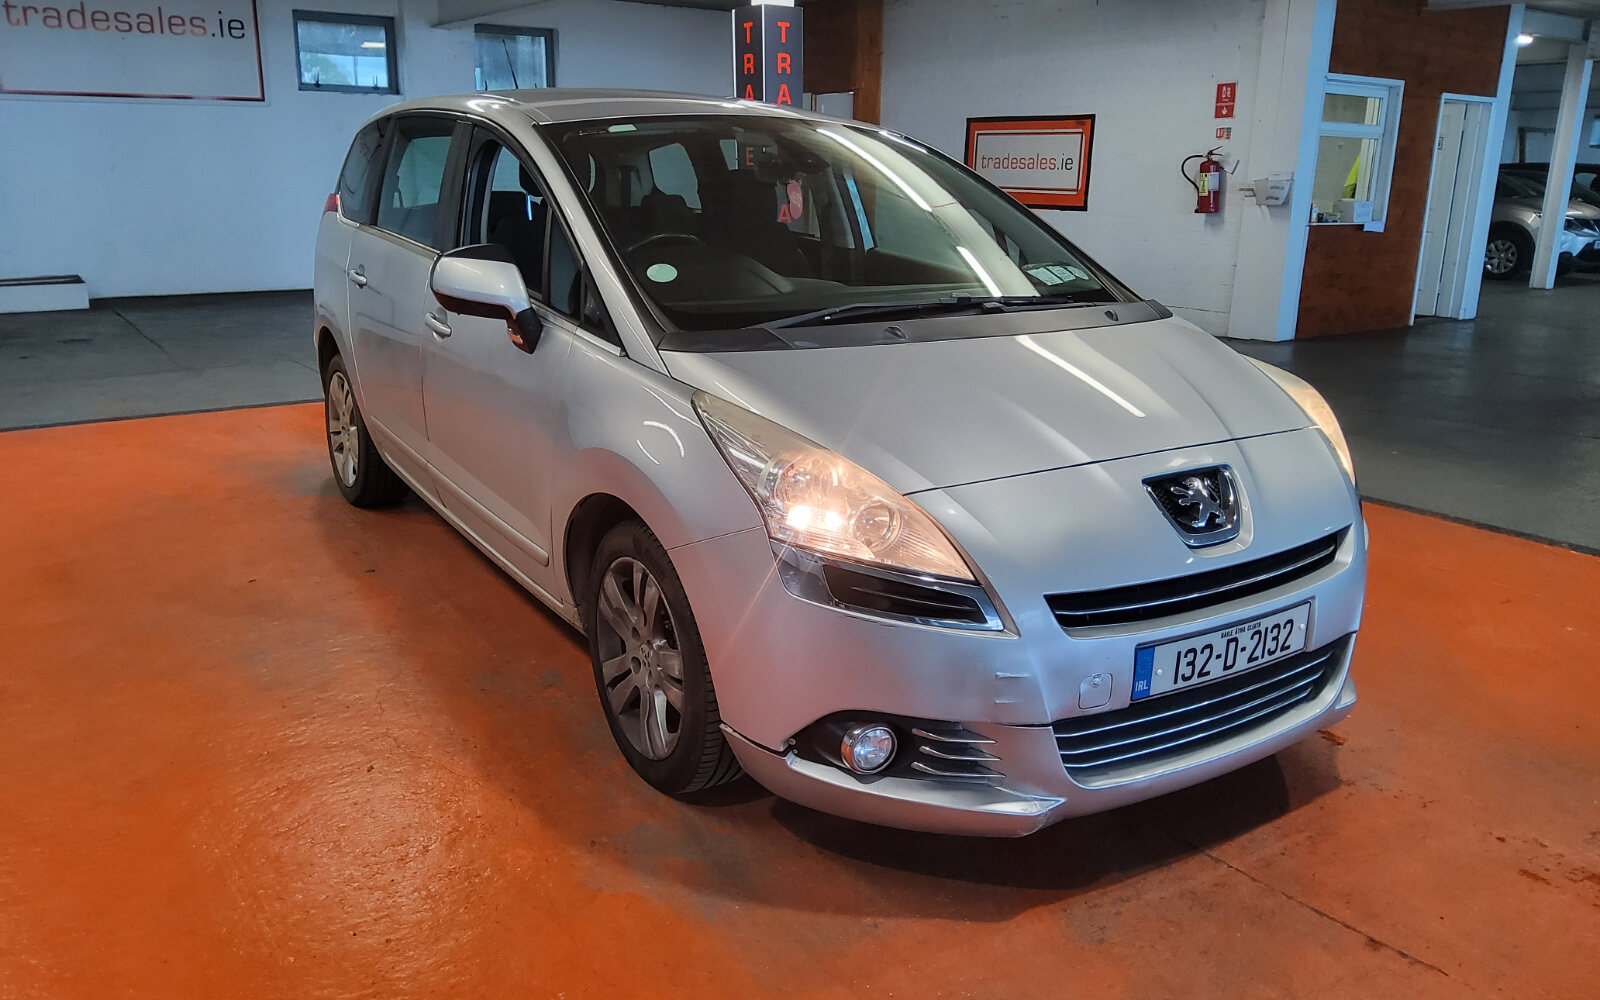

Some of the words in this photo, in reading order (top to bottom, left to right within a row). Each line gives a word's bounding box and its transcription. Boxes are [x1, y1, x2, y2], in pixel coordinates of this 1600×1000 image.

[2, 0, 245, 39] tradesales.ie
[981, 153, 1073, 170] tradesales.ie
[1173, 619, 1294, 685] 132-D-2132
[1135, 680, 1149, 692] IRL
